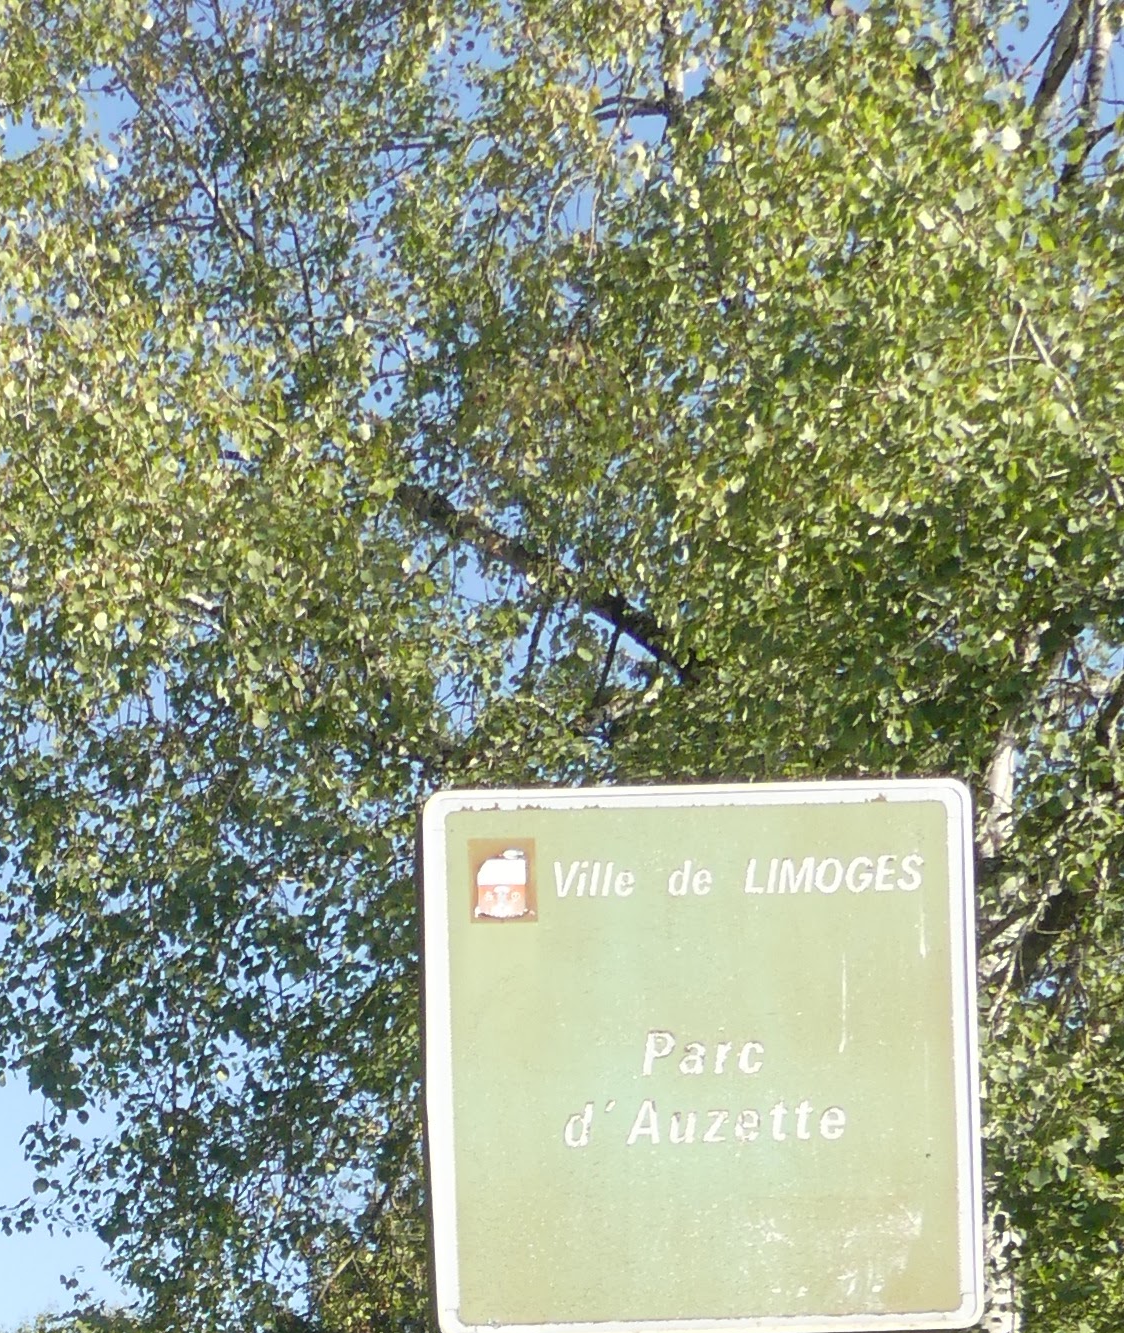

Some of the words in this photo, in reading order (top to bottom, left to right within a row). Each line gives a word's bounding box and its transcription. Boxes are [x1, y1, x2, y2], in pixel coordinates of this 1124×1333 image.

[552, 860, 636, 899] Ville
[667, 859, 714, 898] de
[743, 852, 925, 895] LIMOGES
[641, 1029, 765, 1077] Parc
[563, 1098, 847, 1148] d'Auzette
